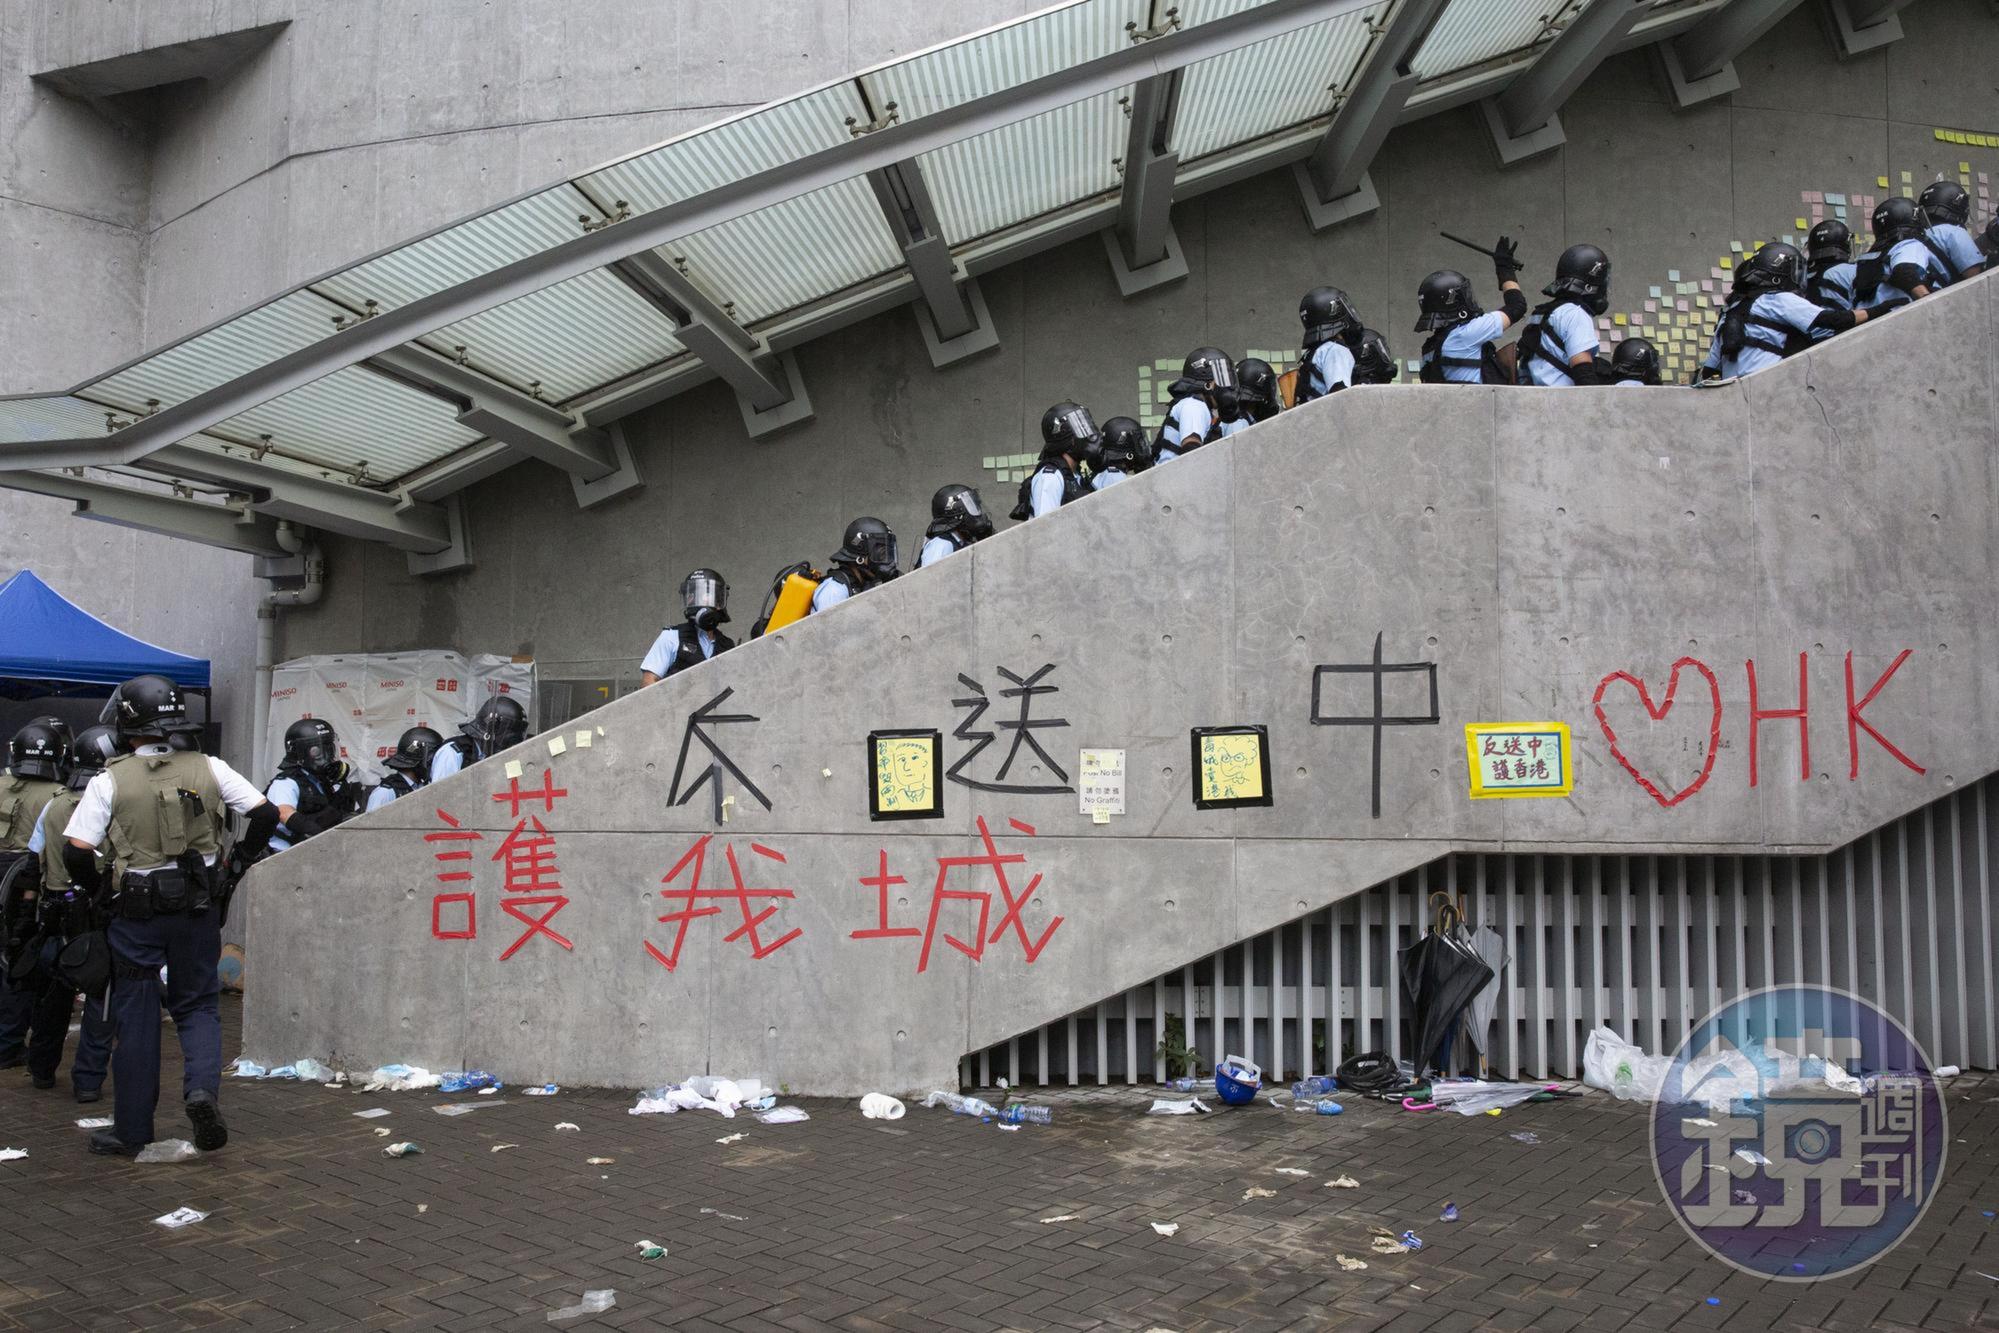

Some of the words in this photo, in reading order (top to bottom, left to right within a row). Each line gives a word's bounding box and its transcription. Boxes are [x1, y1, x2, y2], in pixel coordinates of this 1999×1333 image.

[271, 687, 297, 698] MINISO
[380, 680, 404, 688] MINISO
[1746, 650, 1926, 787] HK
[1483, 735, 1542, 758] 反送中
[1492, 758, 1549, 780] 護香港
[424, 769, 1062, 972] 護我城
